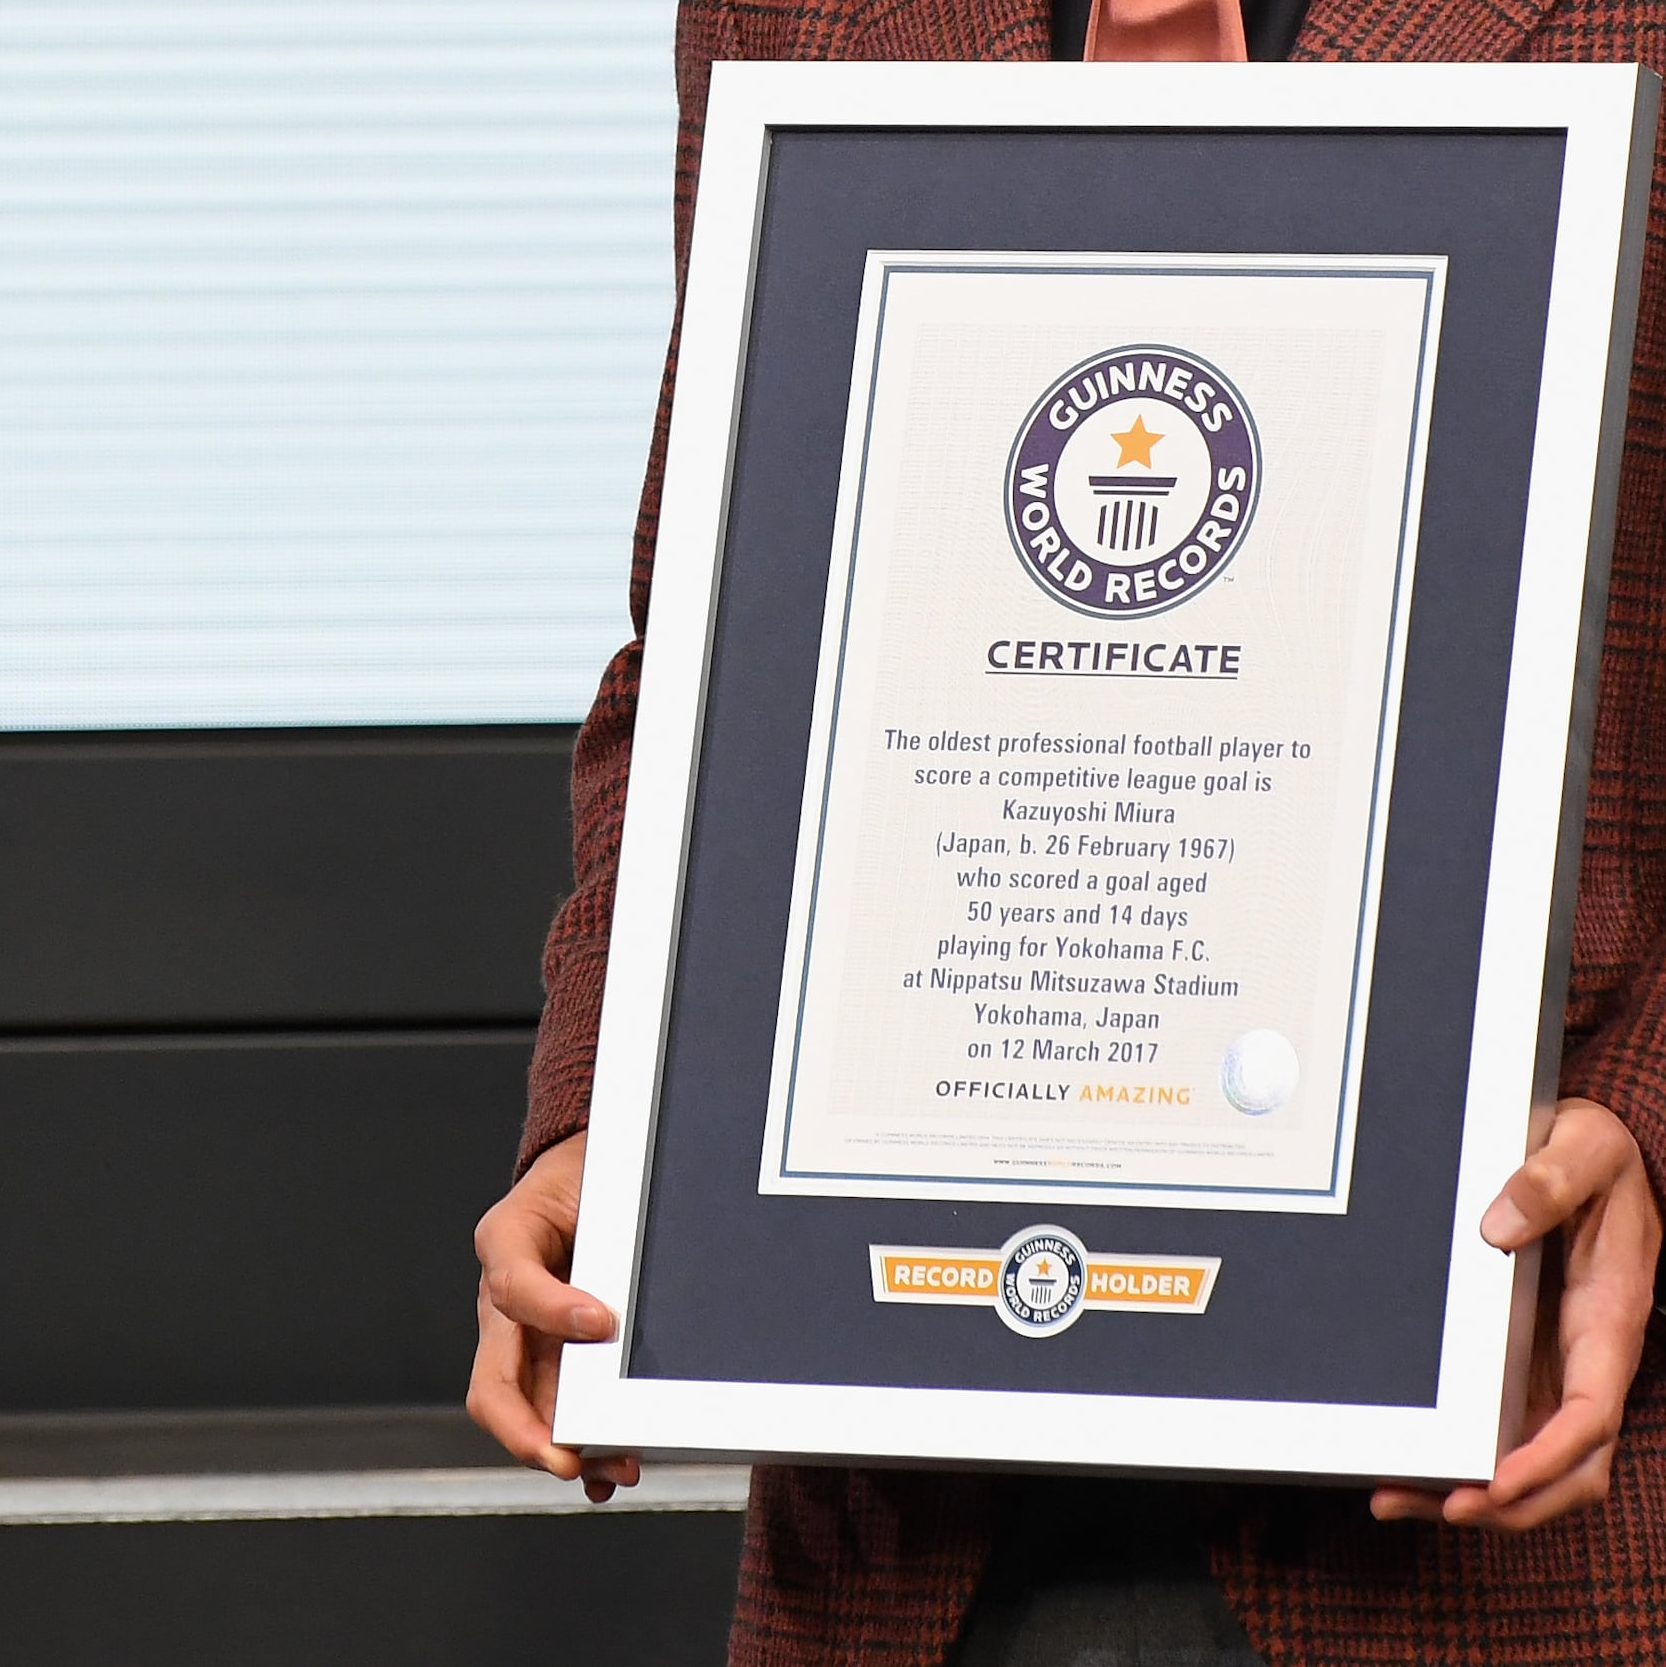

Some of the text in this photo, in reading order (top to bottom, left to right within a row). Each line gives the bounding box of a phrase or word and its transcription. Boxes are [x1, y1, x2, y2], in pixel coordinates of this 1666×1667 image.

[1049, 362, 1233, 433] GUINNESS
[1020, 462, 1247, 604] WORLD RECORDS
[987, 640, 1241, 673] CERTIFICATE
[884, 729, 1311, 763] The oldest professional football player to
[914, 766, 1272, 796] score a competitive league goal is
[1002, 798, 1175, 827] Kazuyoshi Miura
[936, 831, 1235, 864] (Japan, b. 26 February 1967)
[956, 866, 1208, 898] who scored a goal aged
[967, 900, 1188, 932] 50 years and 14 days
[937, 933, 1210, 962] playing for Yokohama F.C.
[903, 967, 1239, 997] at Nippatsu Mitsuzawa Stadium
[974, 1002, 1160, 1034] Yokohama, Japan
[967, 1038, 1159, 1064] on 12 March 2017
[935, 1080, 1192, 1106] OFFICIALLY AMAZING
[1014, 1238, 1076, 1266] GUINNESS
[893, 1264, 1192, 1297] RECORD HOLDER
[1005, 1273, 1081, 1323] WORLD RECORDS
